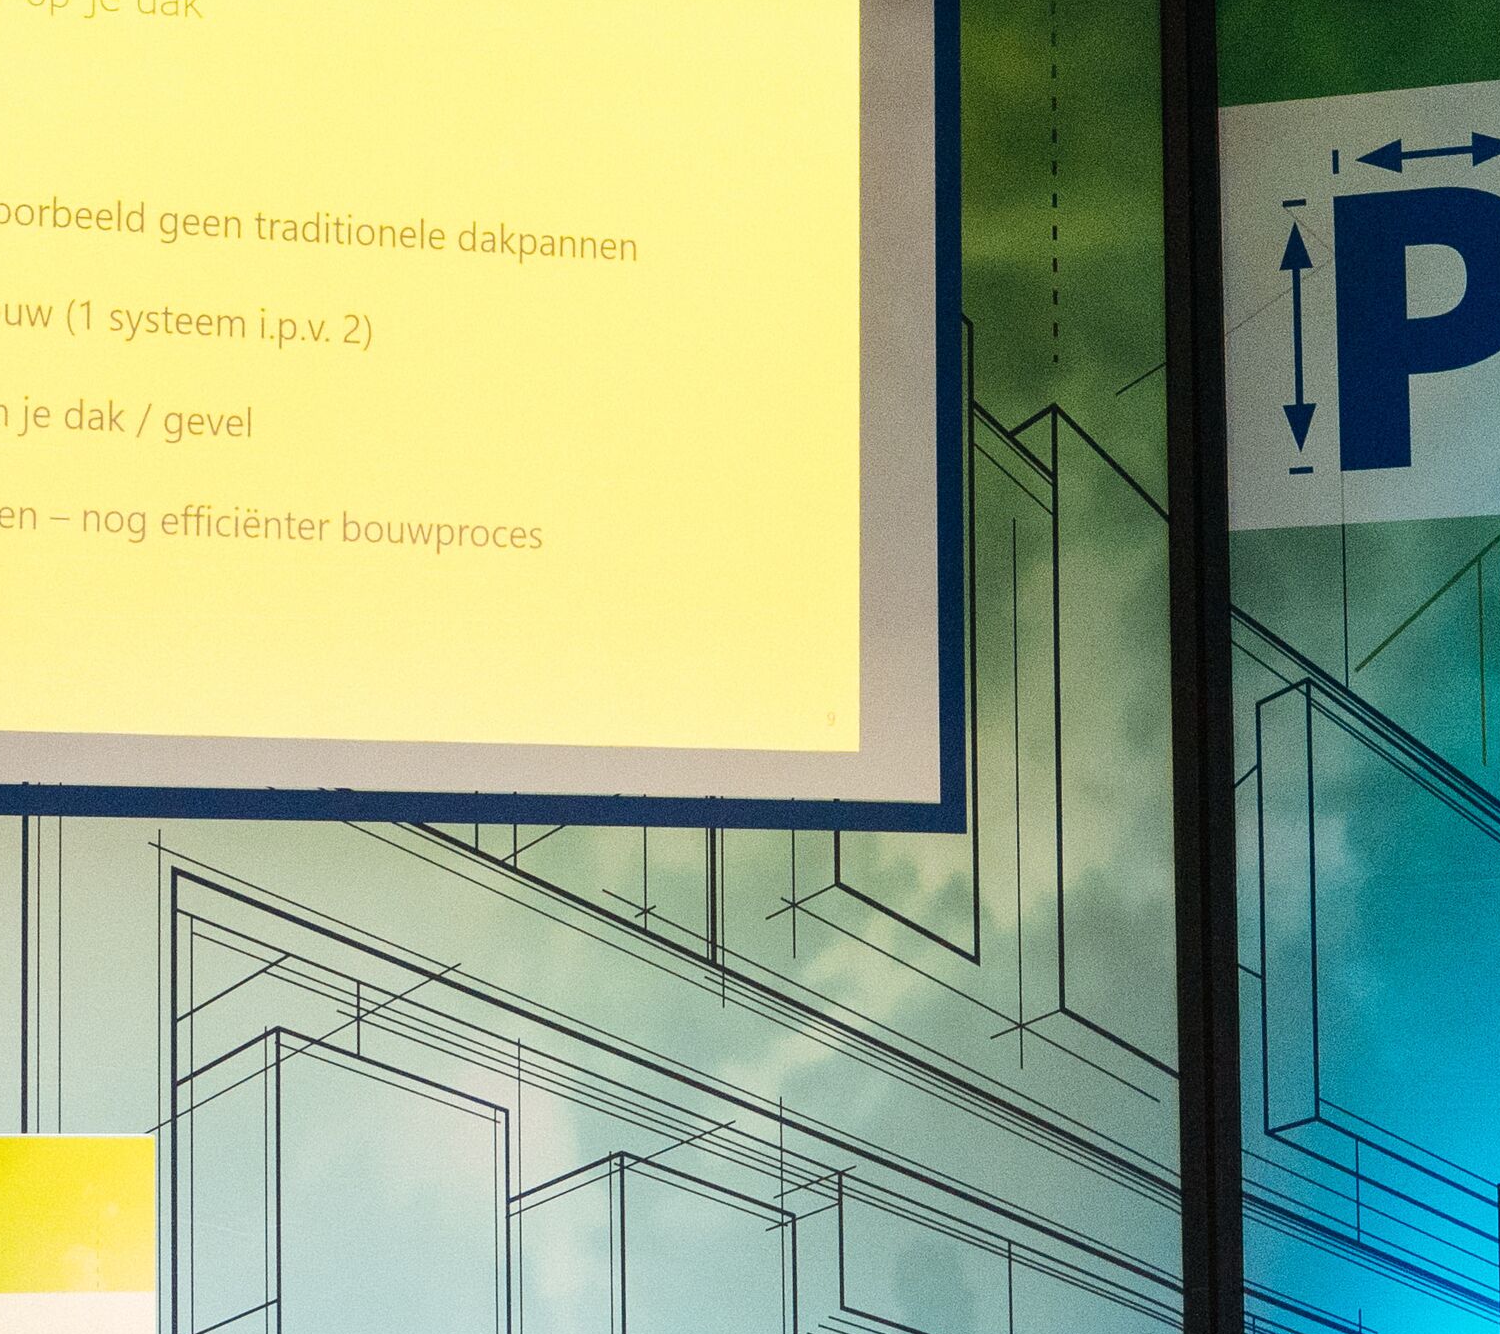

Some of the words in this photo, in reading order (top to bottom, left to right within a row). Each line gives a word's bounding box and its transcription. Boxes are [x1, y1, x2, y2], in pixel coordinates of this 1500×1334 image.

[159, 212, 242, 244] geen
[255, 211, 447, 250] traditionele
[458, 220, 637, 265] dakpannen
[66, 299, 91, 336] (1
[109, 305, 245, 343] systeem
[259, 307, 330, 350] i.p.v.
[343, 313, 373, 352] 2)
[17, 395, 51, 437] je
[64, 398, 125, 432] dak
[164, 406, 252, 444] gevel
[83, 510, 146, 544] nog
[161, 504, 331, 541] efficiënter
[343, 511, 543, 555] bouwproces
